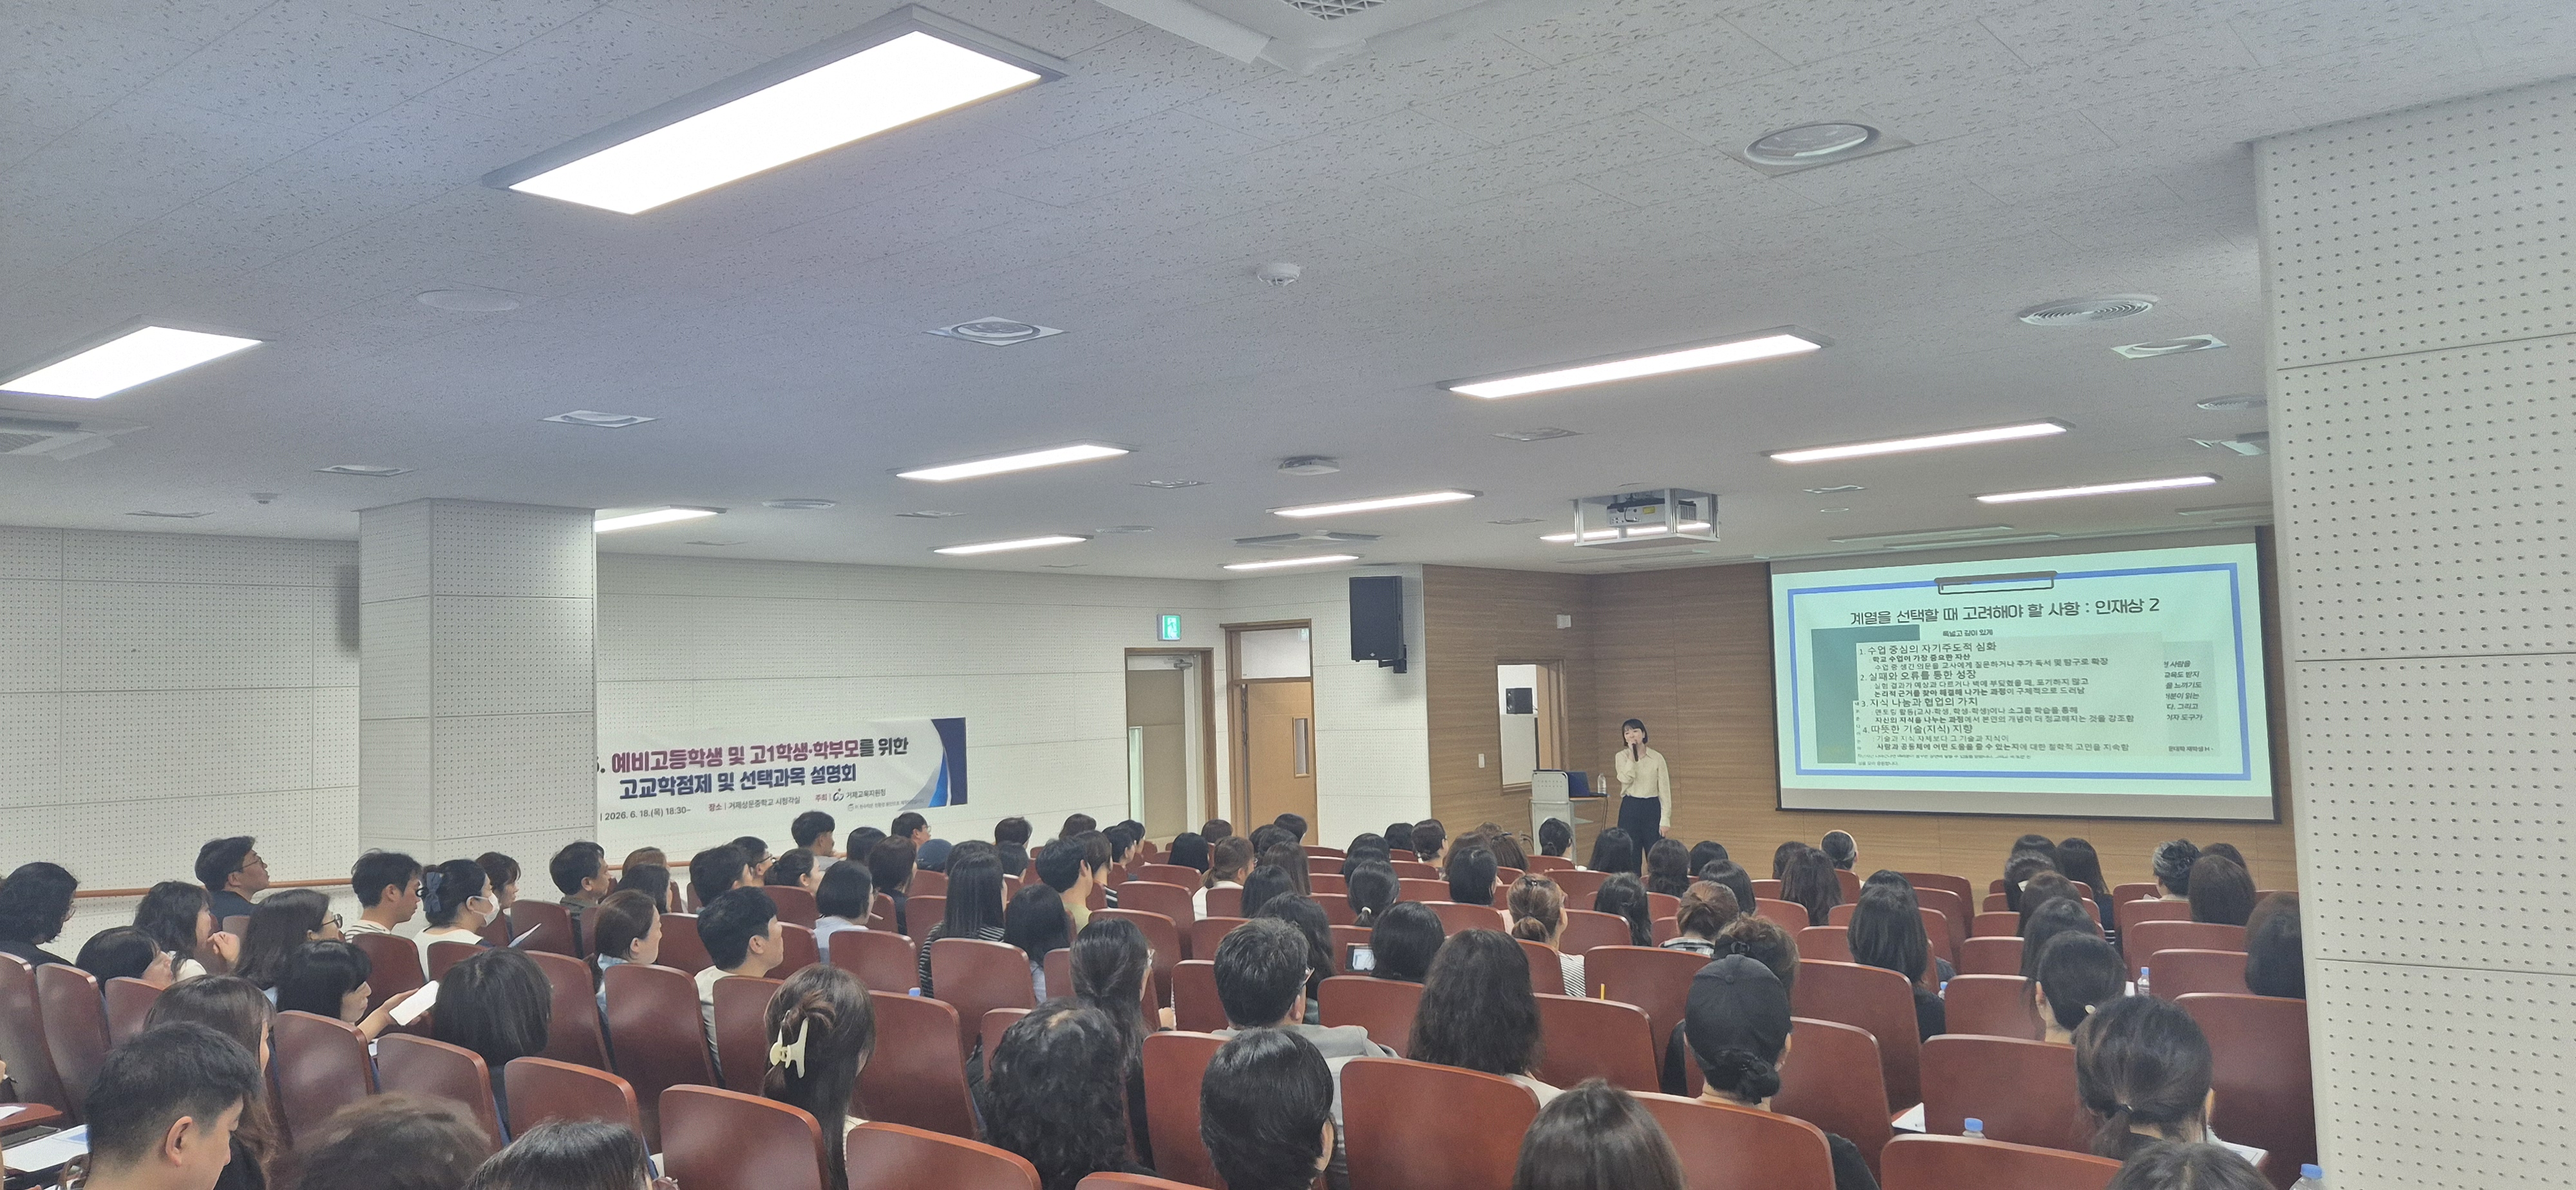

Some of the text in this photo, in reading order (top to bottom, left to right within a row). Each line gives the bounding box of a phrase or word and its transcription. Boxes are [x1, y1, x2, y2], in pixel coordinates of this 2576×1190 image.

[1850, 610, 1891, 625] 계열을
[1897, 608, 1939, 623] 선택할
[1943, 607, 1958, 621] 때
[1963, 604, 2023, 620] 고려해야
[2027, 603, 2043, 618] 할
[2048, 601, 2080, 616] 사항
[2095, 598, 2145, 615] 인재상
[2149, 598, 2160, 612] 2
[1868, 646, 1886, 656] 수업
[1889, 645, 1918, 655] 중심의
[1922, 643, 1973, 653] 자기주도적
[1976, 641, 1997, 652] 심화
[1869, 672, 1898, 681] 실패와
[1900, 670, 1930, 680] 오류를
[1933, 670, 1953, 680] 통한
[1956, 670, 1976, 679] 성장
[1870, 699, 1888, 707] 지식
[1892, 698, 1922, 707] 나눔과
[1924, 697, 1954, 707] 협업의
[1871, 724, 1900, 734] 따뜻한
[1904, 724, 1950, 734] 기술(지식)
[1953, 724, 1973, 733] 지향
[611, 746, 723, 773] 예비고등학생
[728, 745, 746, 766] 및
[878, 737, 909, 756] 위한
[619, 763, 857, 800] 고교학점제 및 선택과목 설명회
[605, 810, 629, 821] 2026.
[630, 810, 638, 818] 6.
[640, 807, 664, 818] 18.(목)
[708, 802, 723, 813] 장소
[728, 798, 774, 810] 거제상문중학교
[775, 796, 800, 806] 시청각실
[815, 793, 828, 802] 주최
[846, 788, 887, 799] 거제교육지원청
